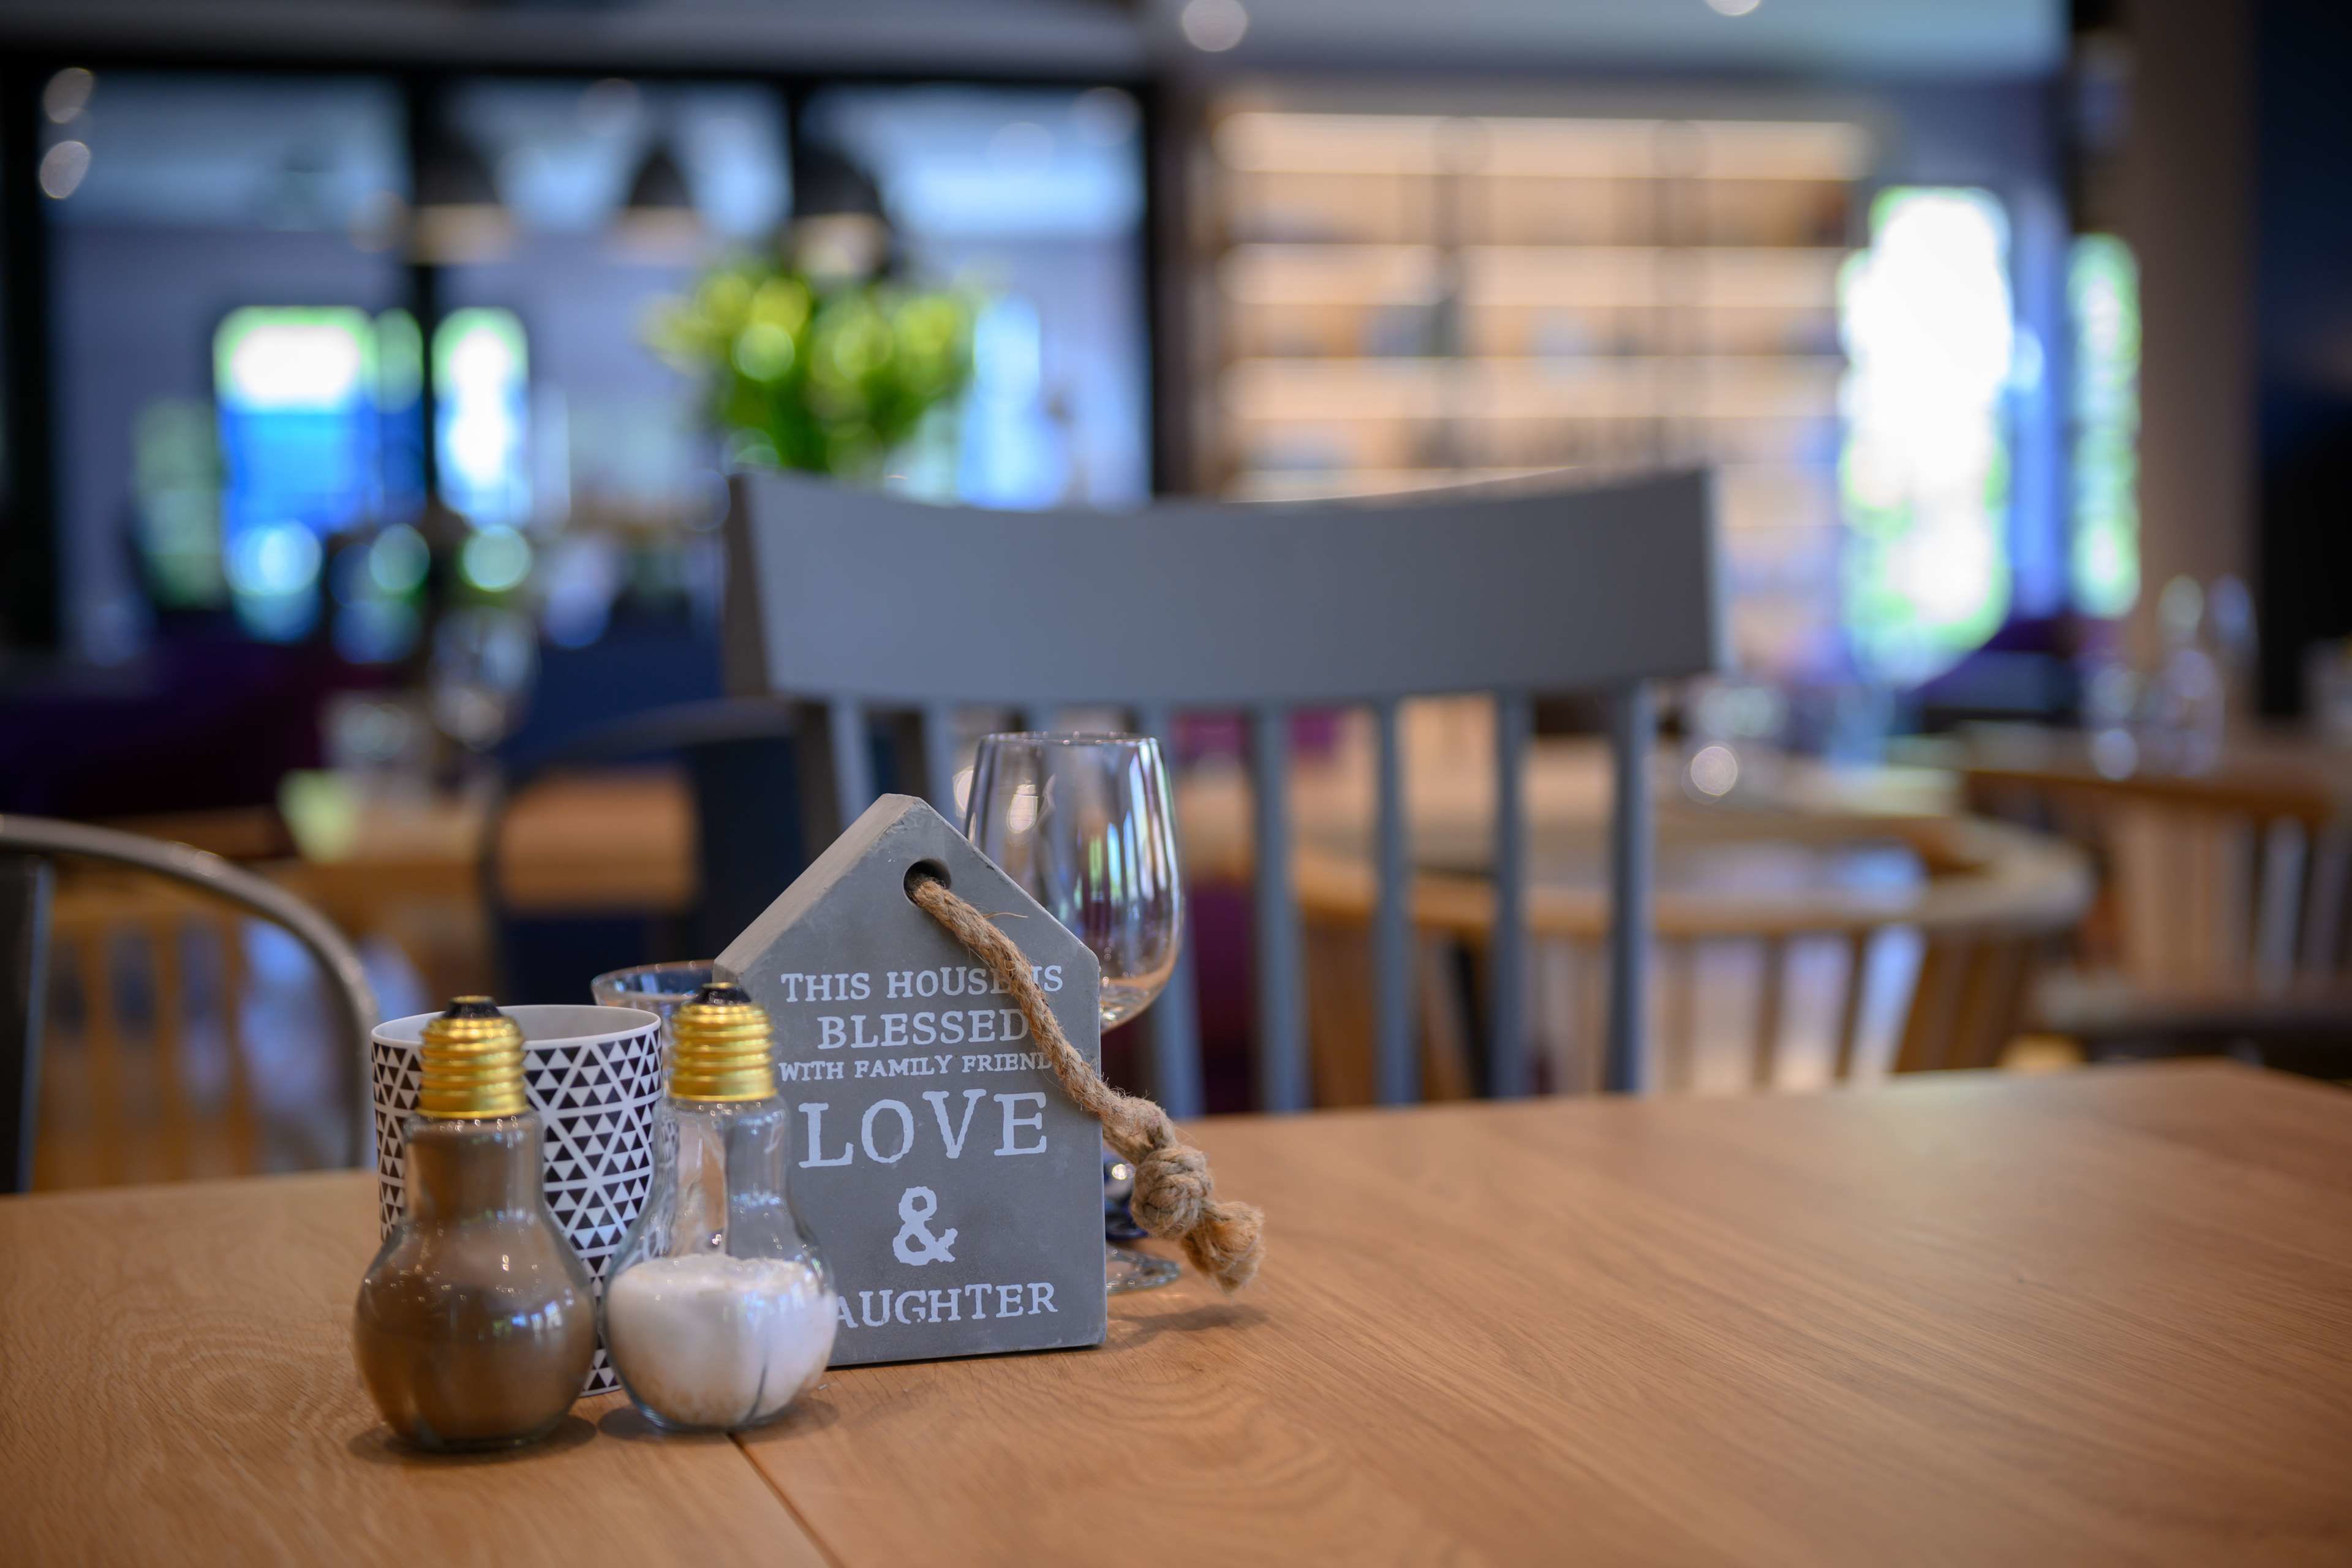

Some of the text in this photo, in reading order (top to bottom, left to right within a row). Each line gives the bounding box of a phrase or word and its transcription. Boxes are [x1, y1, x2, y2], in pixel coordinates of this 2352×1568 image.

[782, 973, 870, 1003] THIS
[817, 1008, 1030, 1049] BLESSED
[778, 1052, 1052, 1082] WITH FAMILY FRIEND
[799, 1089, 1047, 1168] LOVE
[892, 1186, 958, 1266] &
[836, 1283, 1058, 1329] AUGHTER
